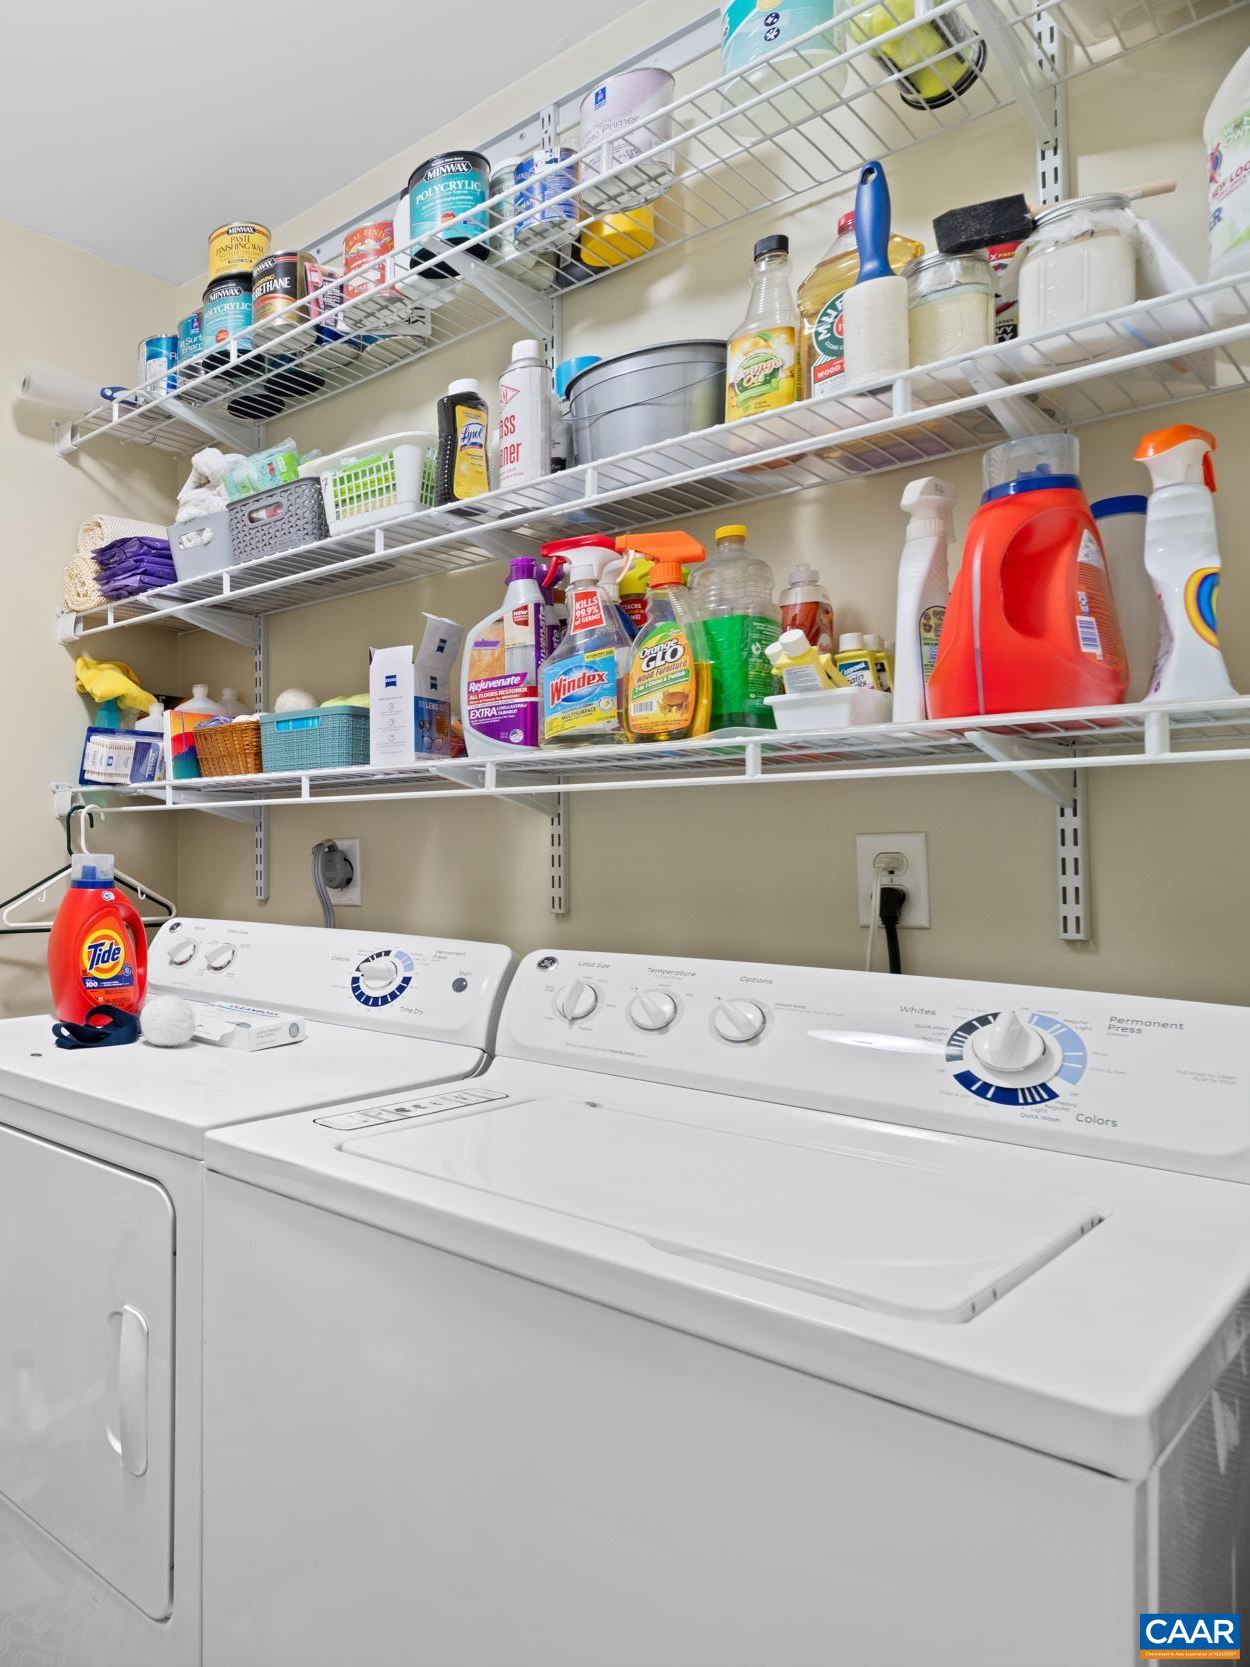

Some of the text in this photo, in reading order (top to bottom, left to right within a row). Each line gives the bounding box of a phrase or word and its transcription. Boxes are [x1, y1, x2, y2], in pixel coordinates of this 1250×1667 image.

[603, 115, 638, 135] Primer
[427, 162, 469, 180] MINWAX
[416, 181, 481, 205] POLYCRYLIC
[229, 226, 254, 234] MINWAX
[216, 243, 250, 256] FINISHING
[252, 243, 264, 253] WAX
[210, 288, 240, 301] MINWAX
[253, 277, 291, 300] URETHANE
[735, 359, 782, 384] Orange
[743, 371, 765, 387] Oil
[817, 365, 842, 378] WOOD
[461, 425, 484, 445] Lysol
[500, 415, 516, 439] ass
[500, 442, 522, 468] aner
[575, 596, 598, 610] KILLS
[575, 605, 599, 619] 99.9%
[640, 638, 678, 659] Orange
[642, 644, 685, 672] GLO
[637, 661, 688, 684] Wood Furniture
[469, 676, 521, 692] Rejuvenate
[550, 672, 607, 708] Windex
[479, 690, 498, 698] FLOORS
[499, 687, 528, 695] RESTORER
[470, 707, 497, 720] EXTRA
[87, 941, 121, 971] Tide
[647, 967, 697, 977] Temperature
[740, 975, 774, 985] Options
[900, 1005, 937, 1016] Whites
[1107, 1024, 1143, 1035] Press
[1109, 1016, 1185, 1030] Permanent
[1075, 1113, 1118, 1127] Colors
